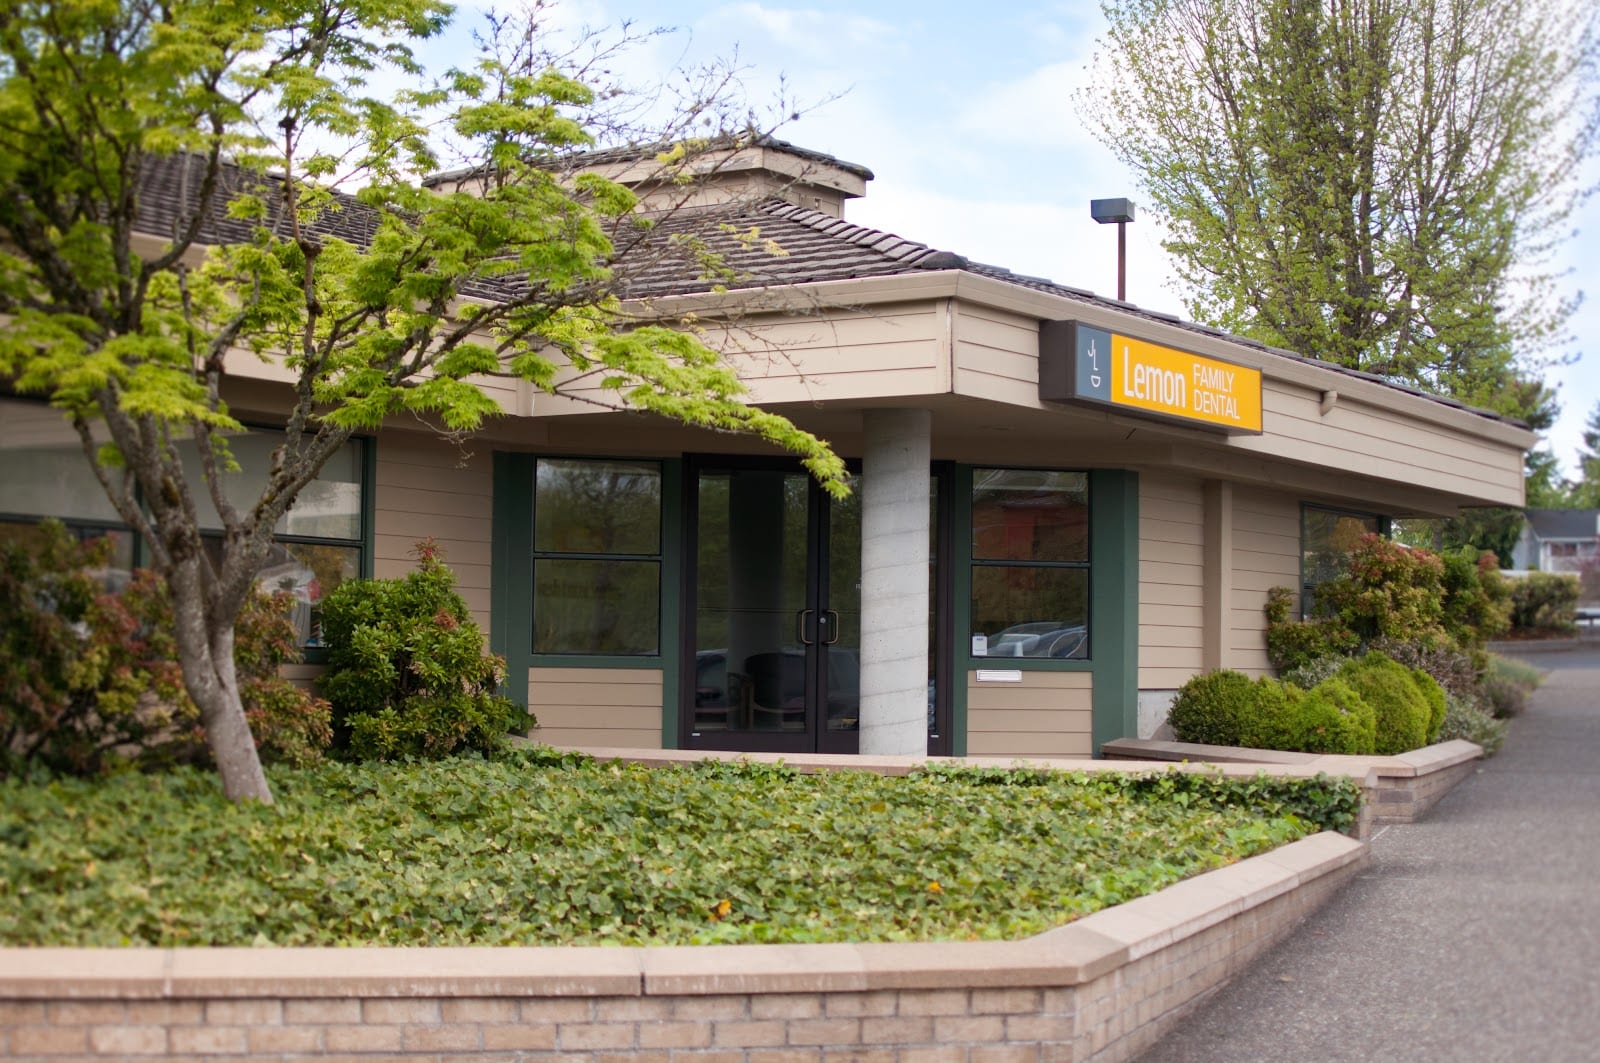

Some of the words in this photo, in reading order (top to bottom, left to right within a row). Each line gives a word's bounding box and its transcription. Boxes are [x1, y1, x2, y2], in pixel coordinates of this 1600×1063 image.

[1123, 346, 1186, 408] Lemon
[1192, 364, 1235, 393] FAMILY
[1194, 390, 1240, 420] DENTAL
